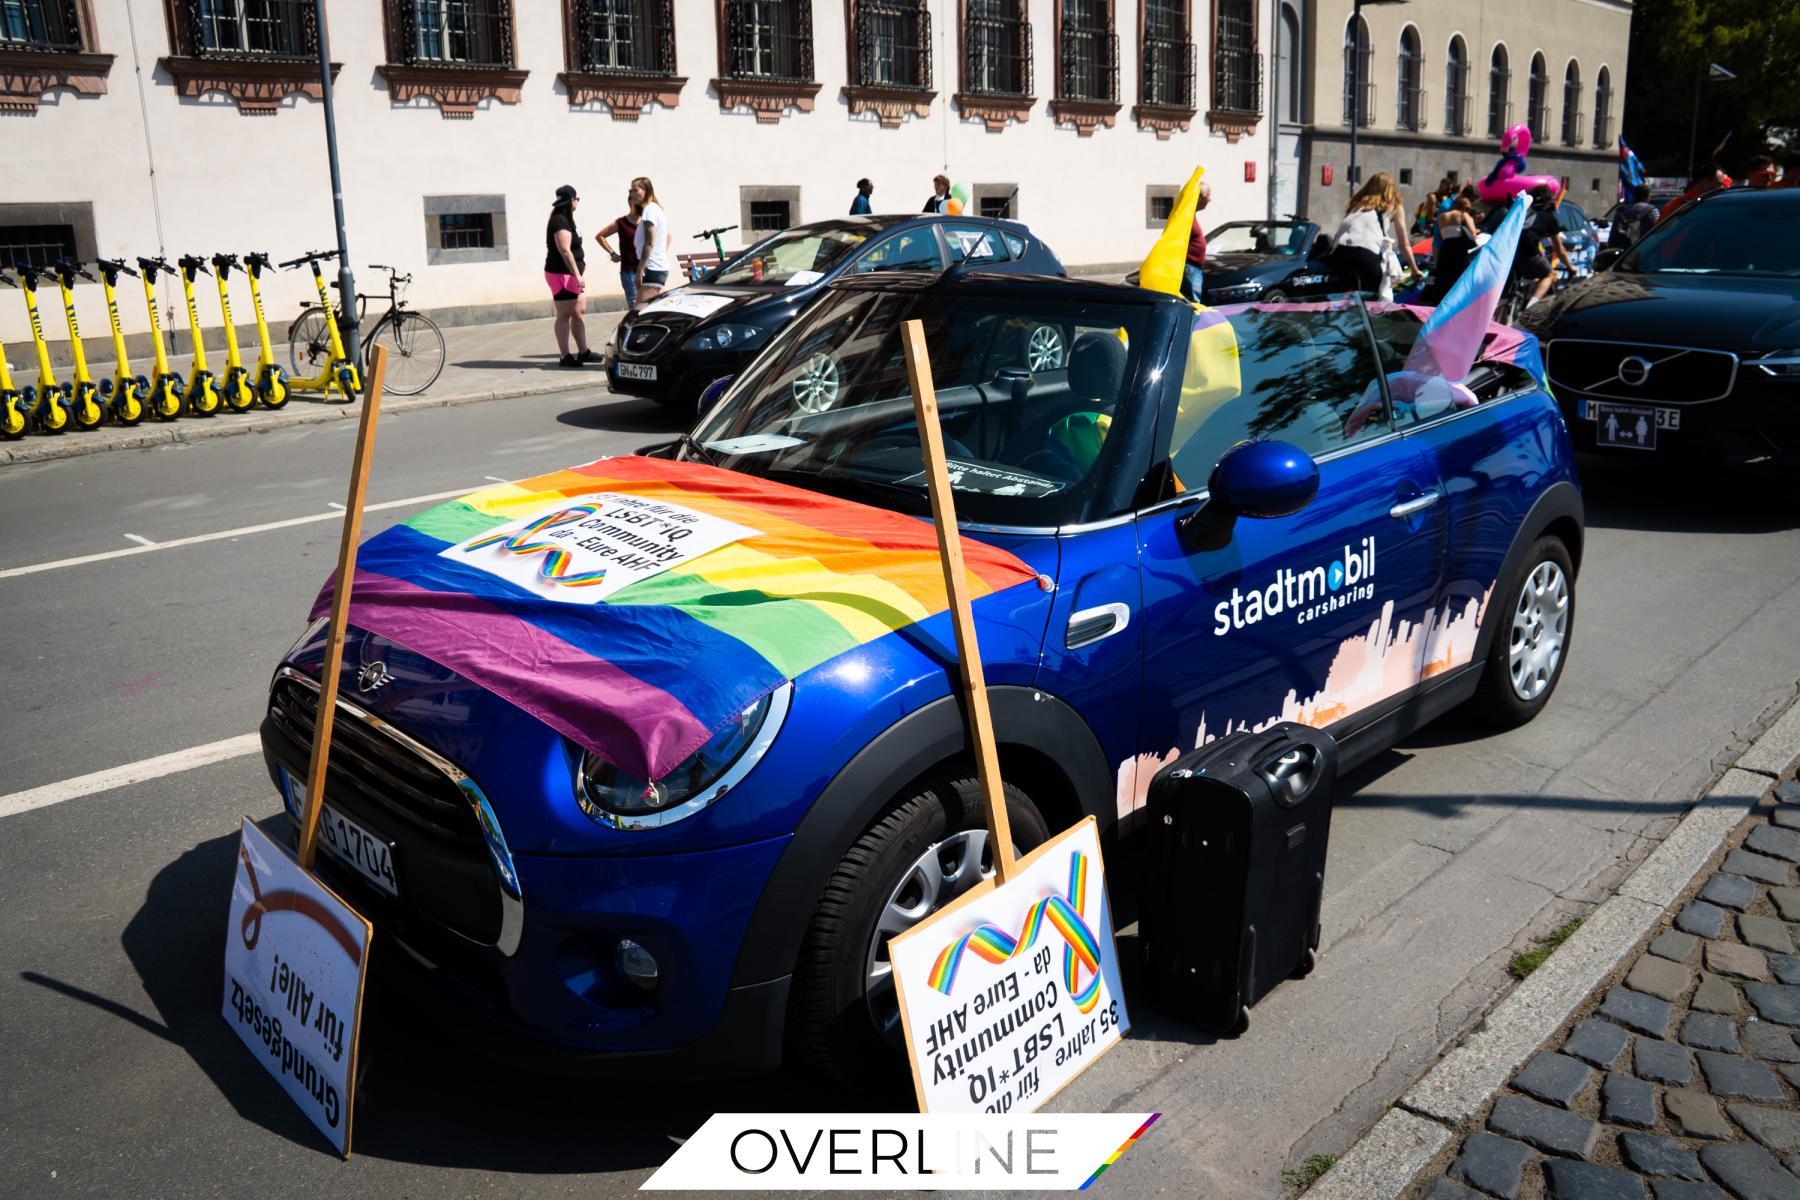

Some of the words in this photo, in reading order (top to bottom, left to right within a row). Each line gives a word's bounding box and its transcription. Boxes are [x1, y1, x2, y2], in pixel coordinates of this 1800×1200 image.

[638, 366, 653, 378] 797
[1587, 402, 1596, 419] M
[969, 467, 1001, 479] haltet
[576, 536, 618, 556] Eure
[610, 553, 661, 571] AHF
[578, 518, 684, 562] Community
[1297, 583, 1374, 625] carsharing
[338, 819, 394, 888] 1704
[1033, 945, 1051, 974] da
[270, 954, 313, 1026] Alle!
[974, 971, 1020, 1015] Eure
[317, 1006, 344, 1061] für
[926, 1002, 968, 1056] AHF
[933, 981, 1058, 1085] Community
[1100, 999, 1119, 1036] 35
[232, 978, 340, 1128] Grundgesetz
[1055, 1018, 1096, 1066] Jahre
[1017, 1066, 1039, 1101] für
